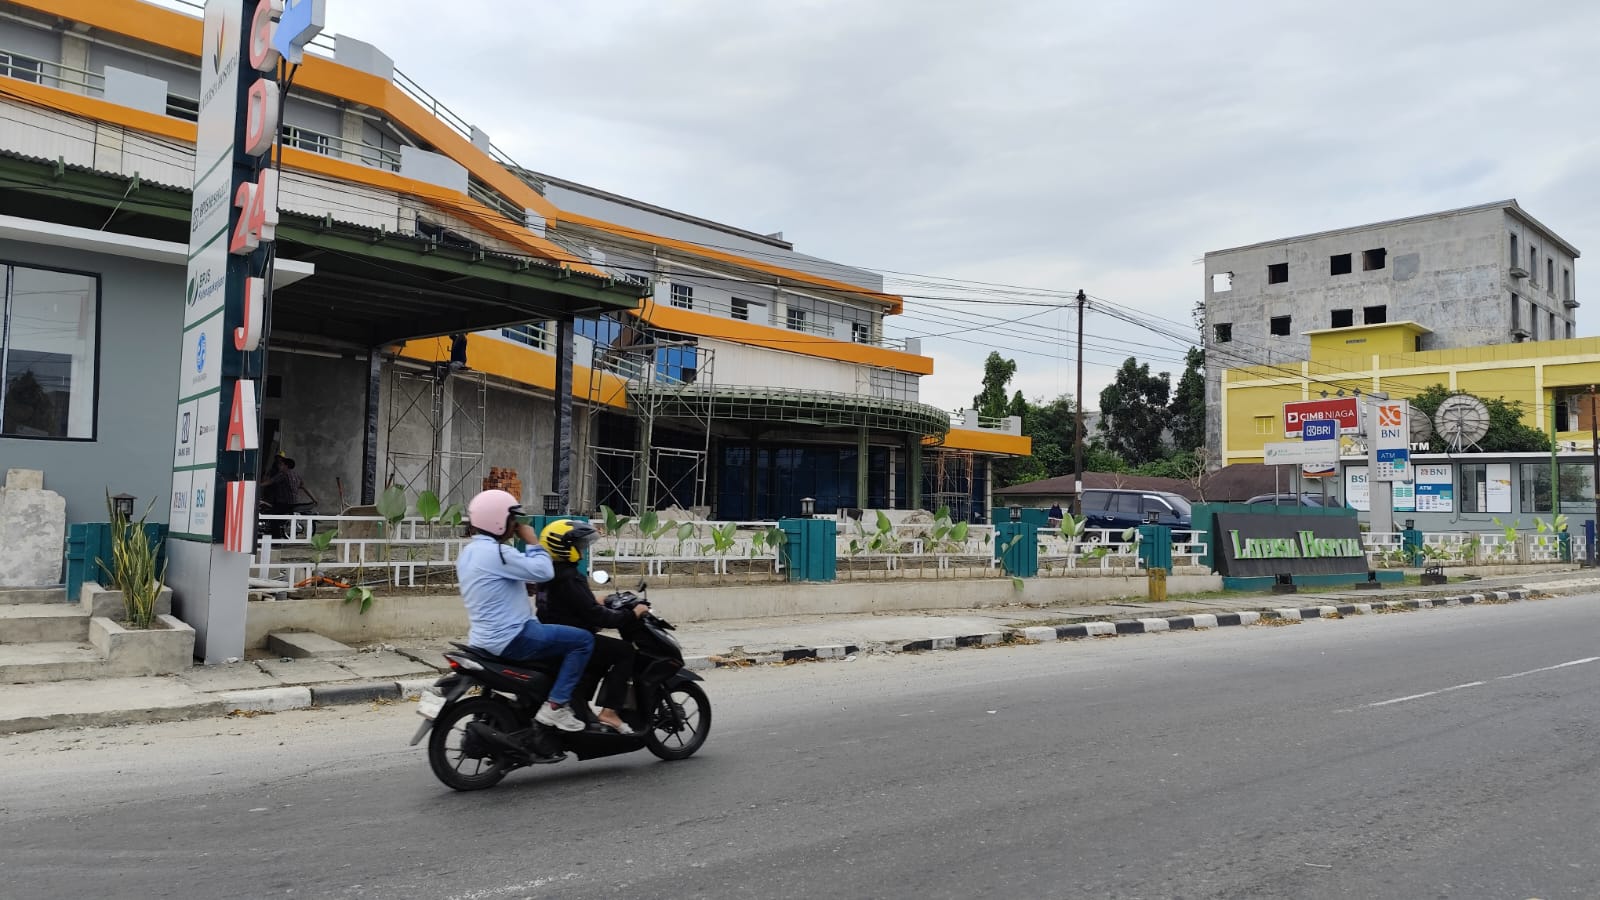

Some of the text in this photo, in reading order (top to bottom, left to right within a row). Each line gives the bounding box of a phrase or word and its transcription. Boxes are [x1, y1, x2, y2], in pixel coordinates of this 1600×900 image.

[229, 168, 279, 255] 24
[1300, 410, 1355, 421] CIMB NIAGA
[1316, 426, 1331, 435] BRI
[1381, 429, 1400, 438] BNI
[1430, 468, 1447, 476] BNI
[1351, 475, 1367, 483] BSI
